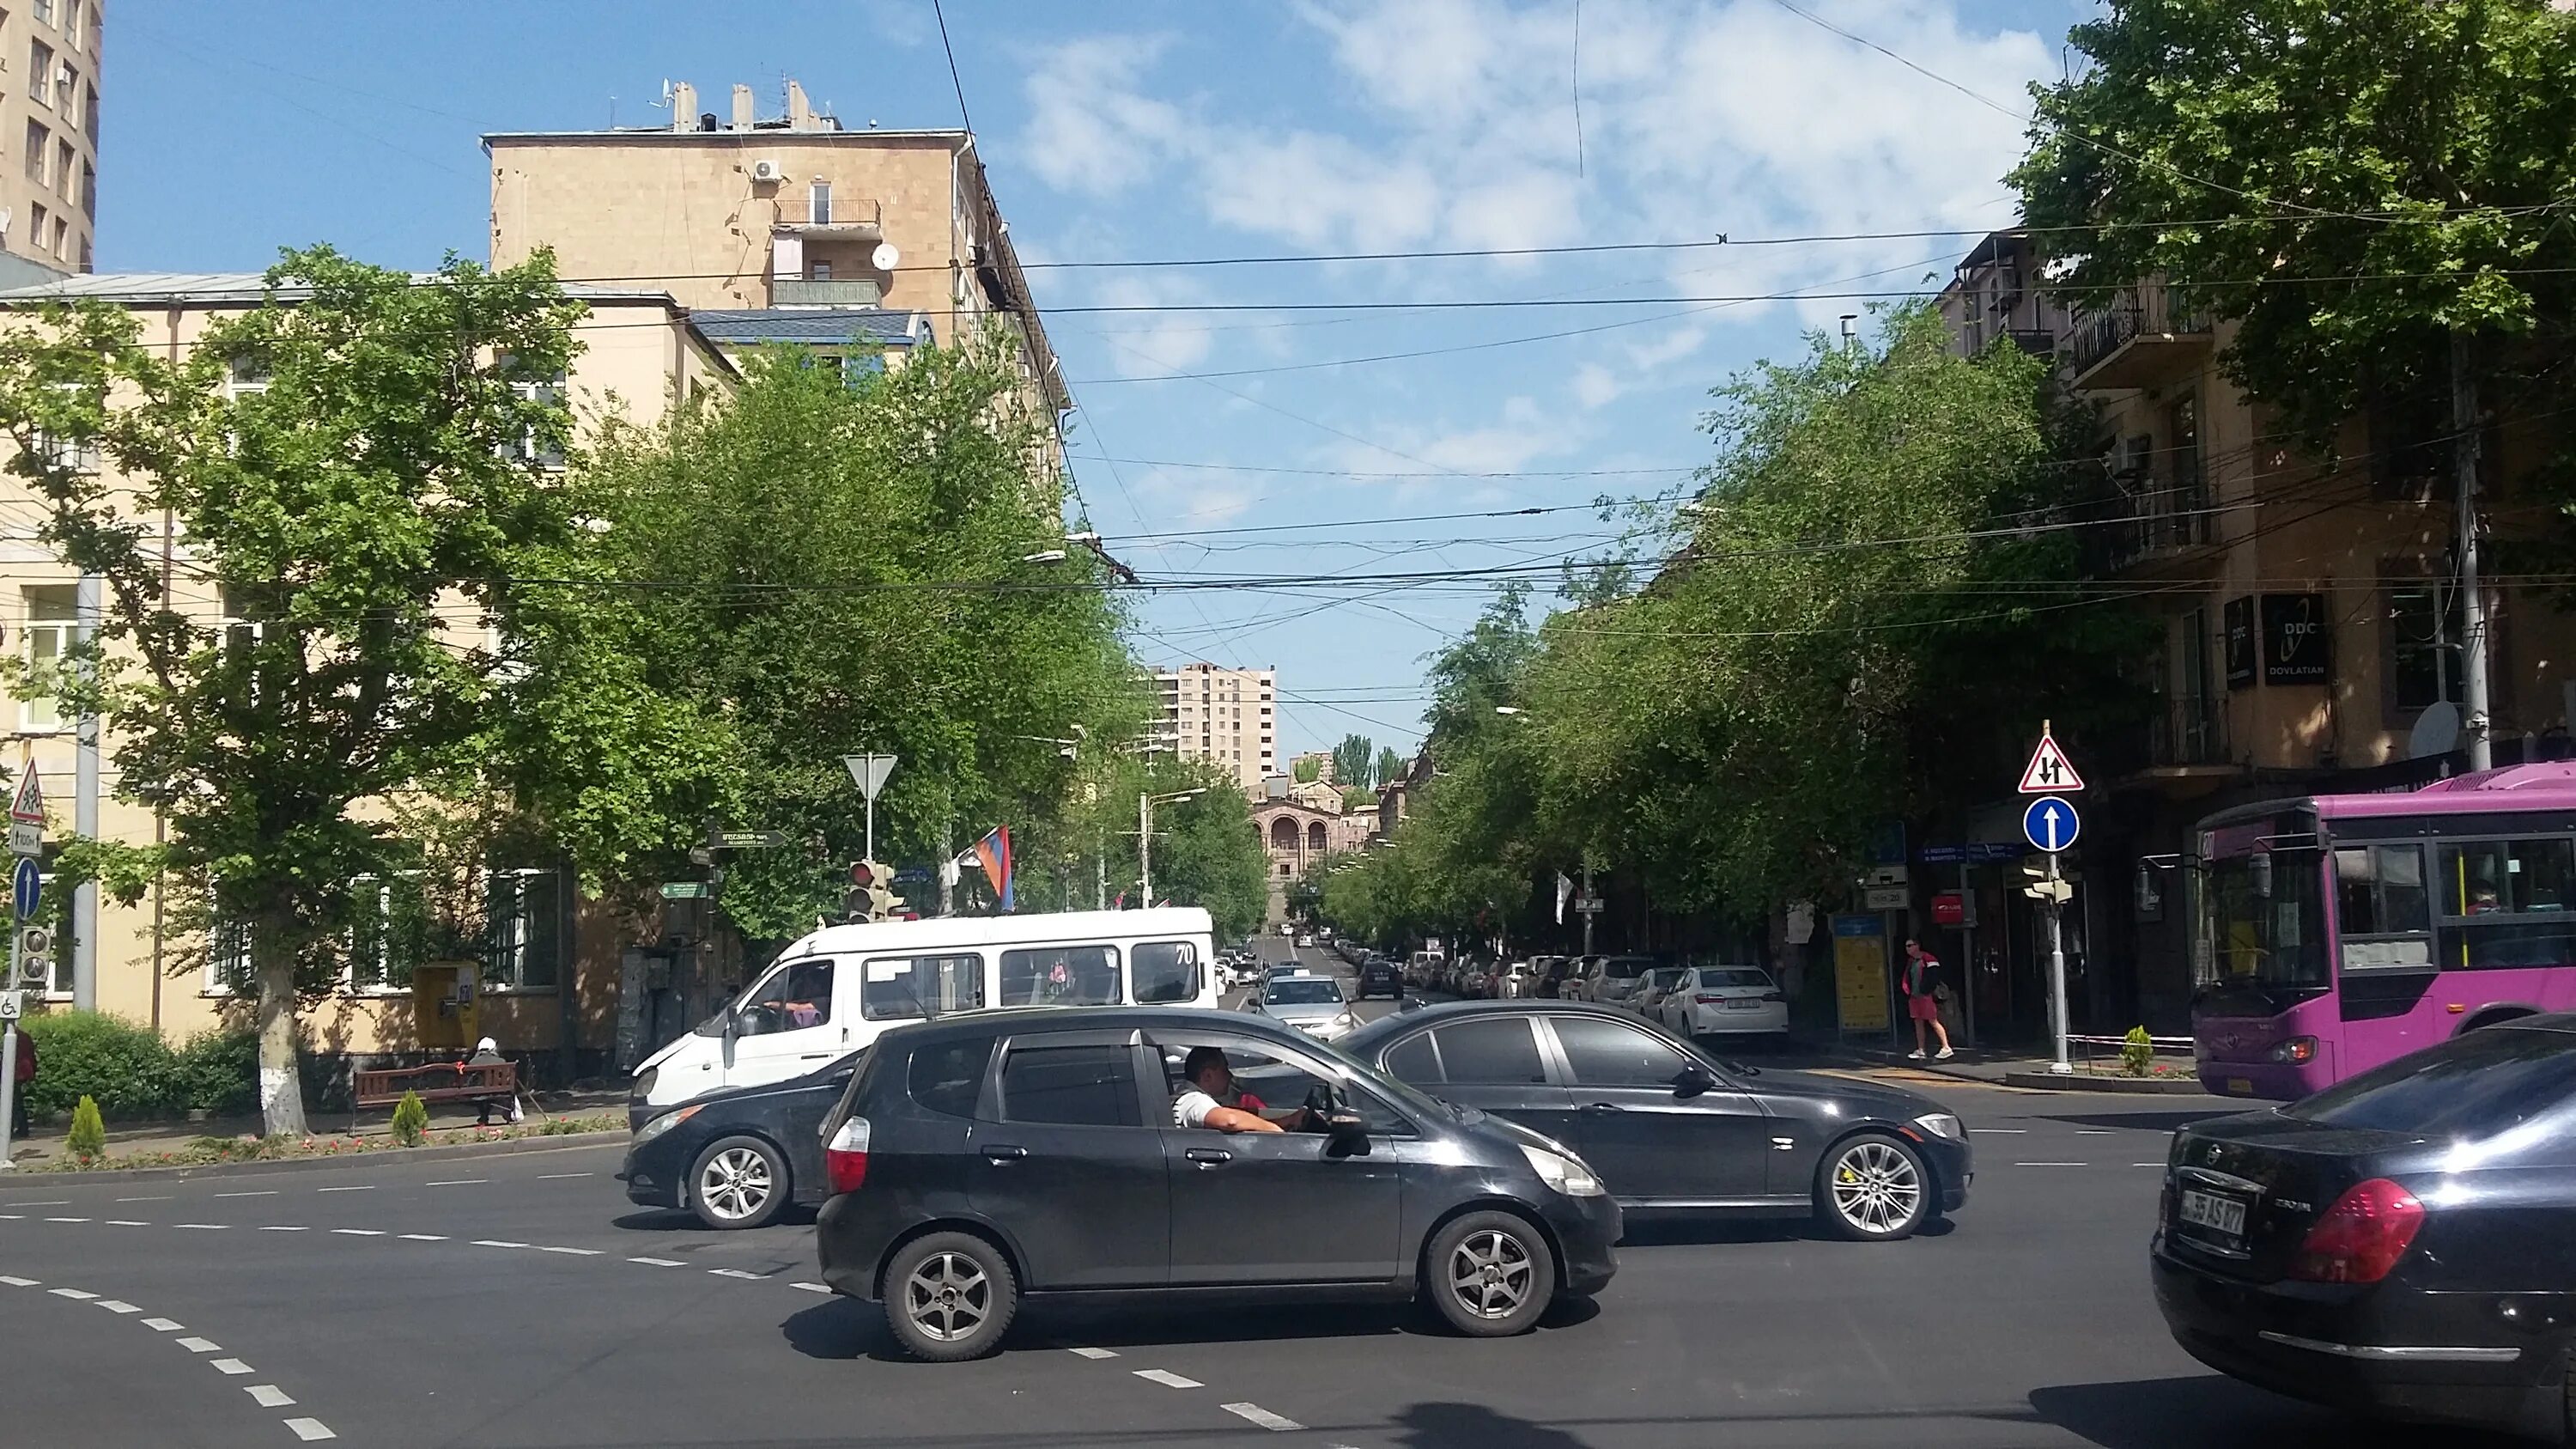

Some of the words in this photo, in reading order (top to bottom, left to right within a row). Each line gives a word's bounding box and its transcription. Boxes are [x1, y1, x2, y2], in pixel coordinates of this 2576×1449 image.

[2285, 623, 2316, 635] DDC
[2269, 667, 2324, 675] DOVLATIAN
[1176, 944, 1194, 965] 70
[2207, 1199, 2224, 1226] AS
